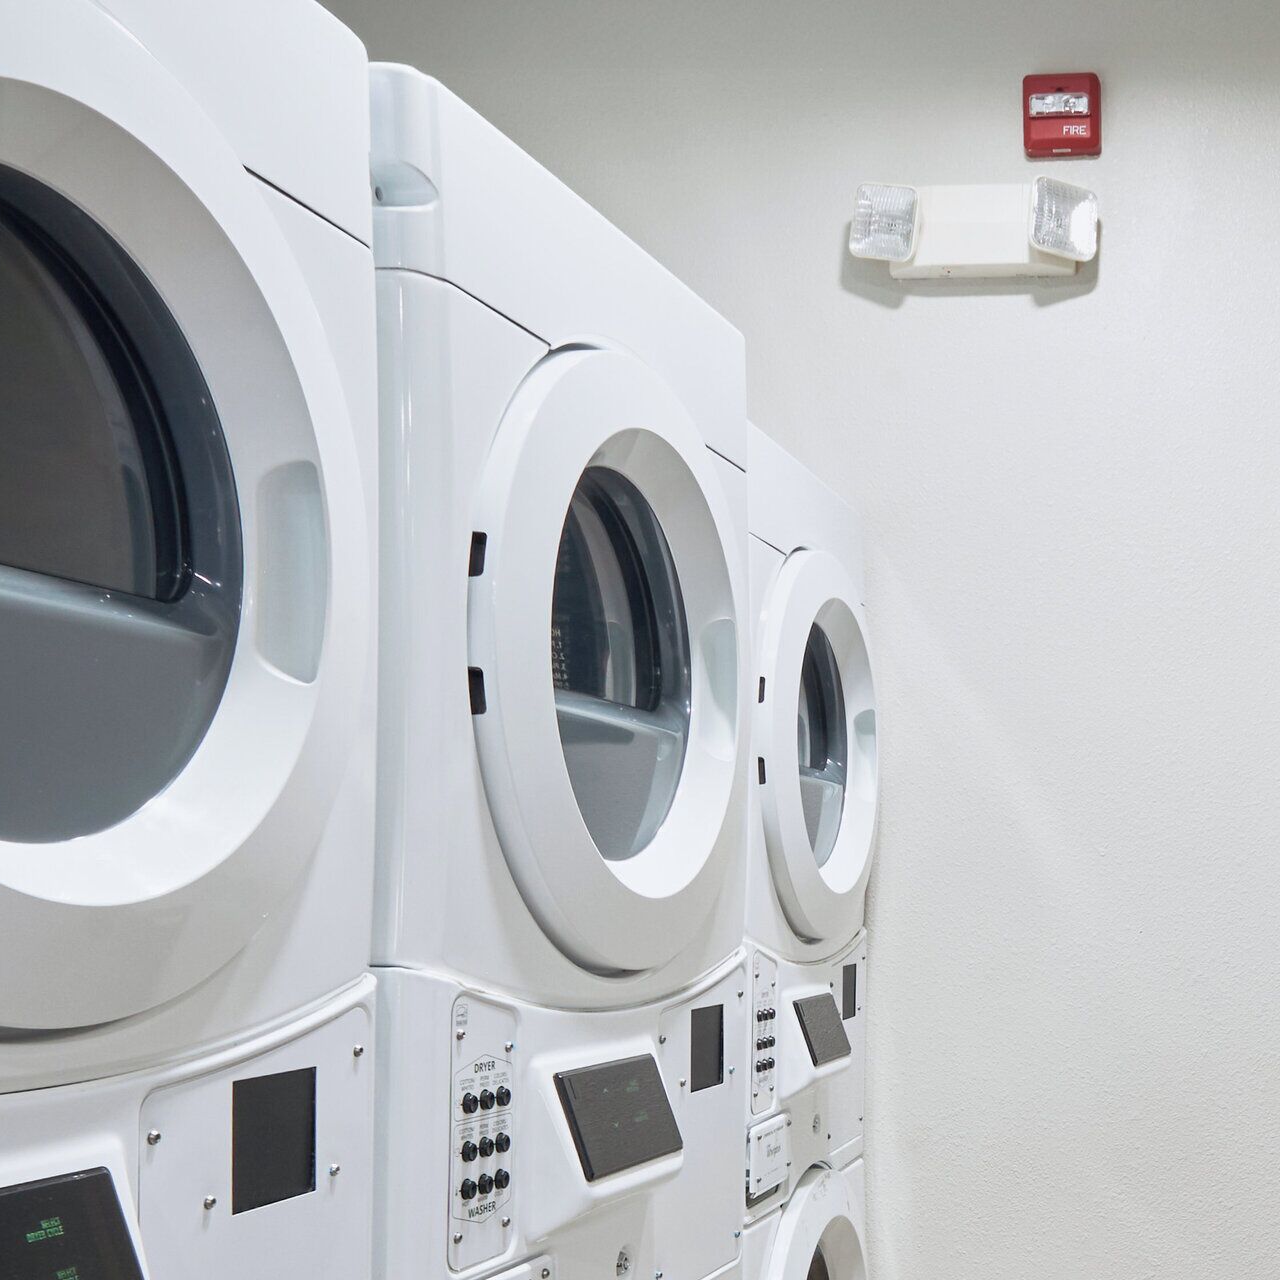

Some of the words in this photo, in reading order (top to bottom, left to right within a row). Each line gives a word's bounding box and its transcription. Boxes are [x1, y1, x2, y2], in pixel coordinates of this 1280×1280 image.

[1063, 125, 1087, 136] FIRE
[474, 1061, 496, 1073] DRYER
[468, 1201, 496, 1218] WASHER
